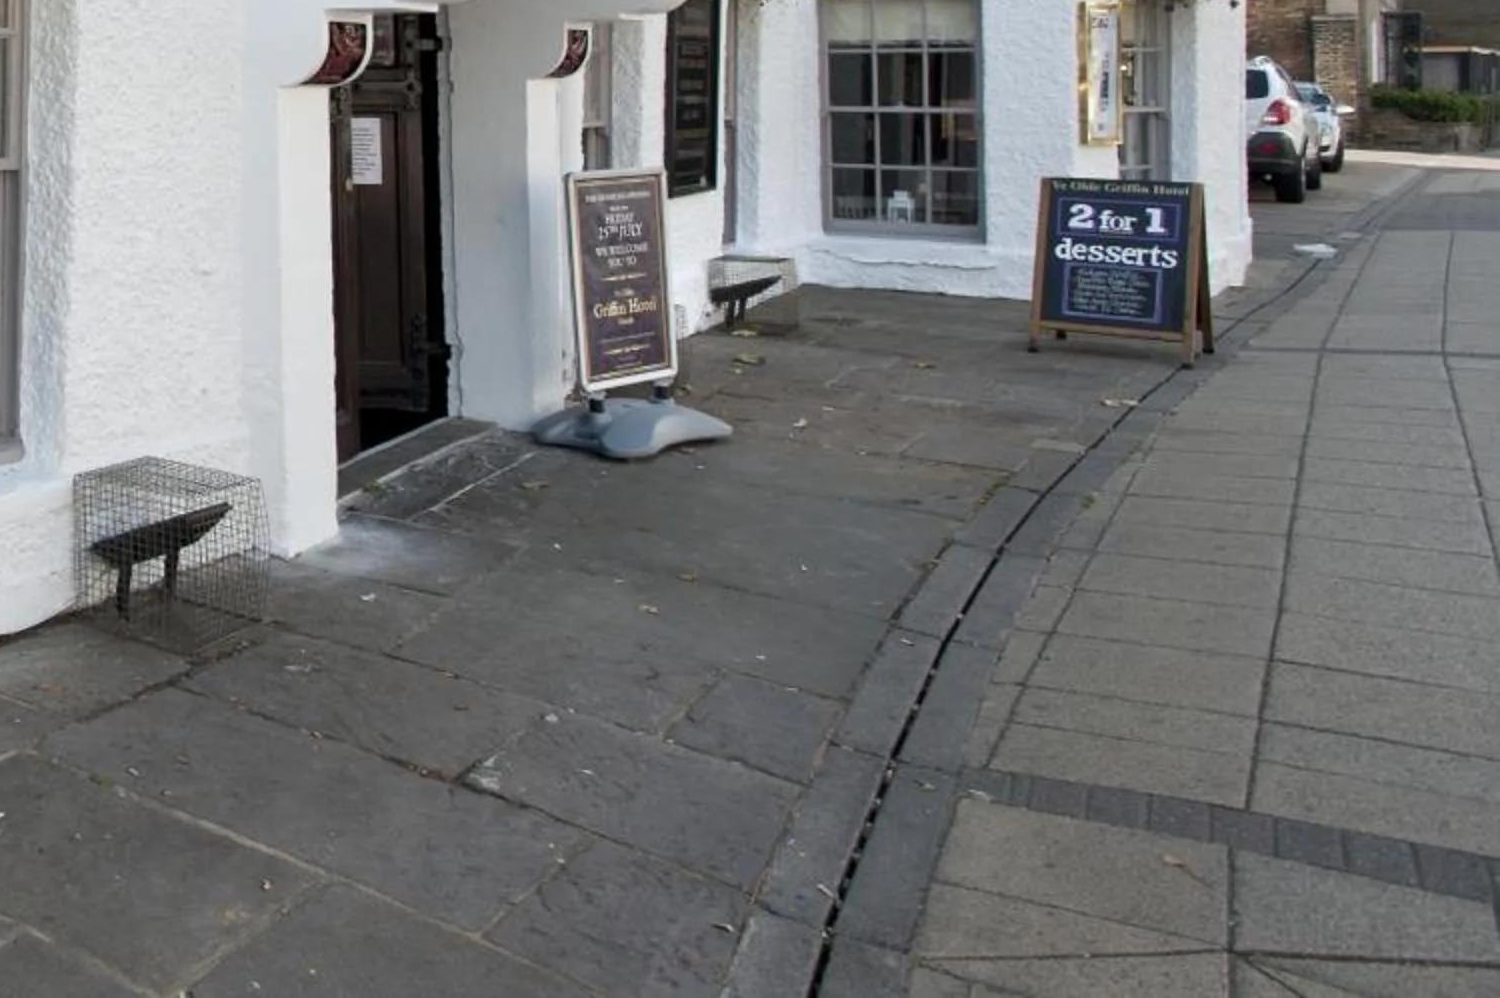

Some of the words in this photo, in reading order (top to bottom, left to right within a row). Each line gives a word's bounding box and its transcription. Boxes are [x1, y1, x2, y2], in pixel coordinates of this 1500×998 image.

[1104, 183, 1149, 194] Griffin
[1153, 185, 1190, 196] Hotel
[1067, 203, 1094, 229] 2
[1099, 209, 1138, 231] for
[1145, 207, 1167, 233] 1
[1054, 237, 1179, 269] desserts
